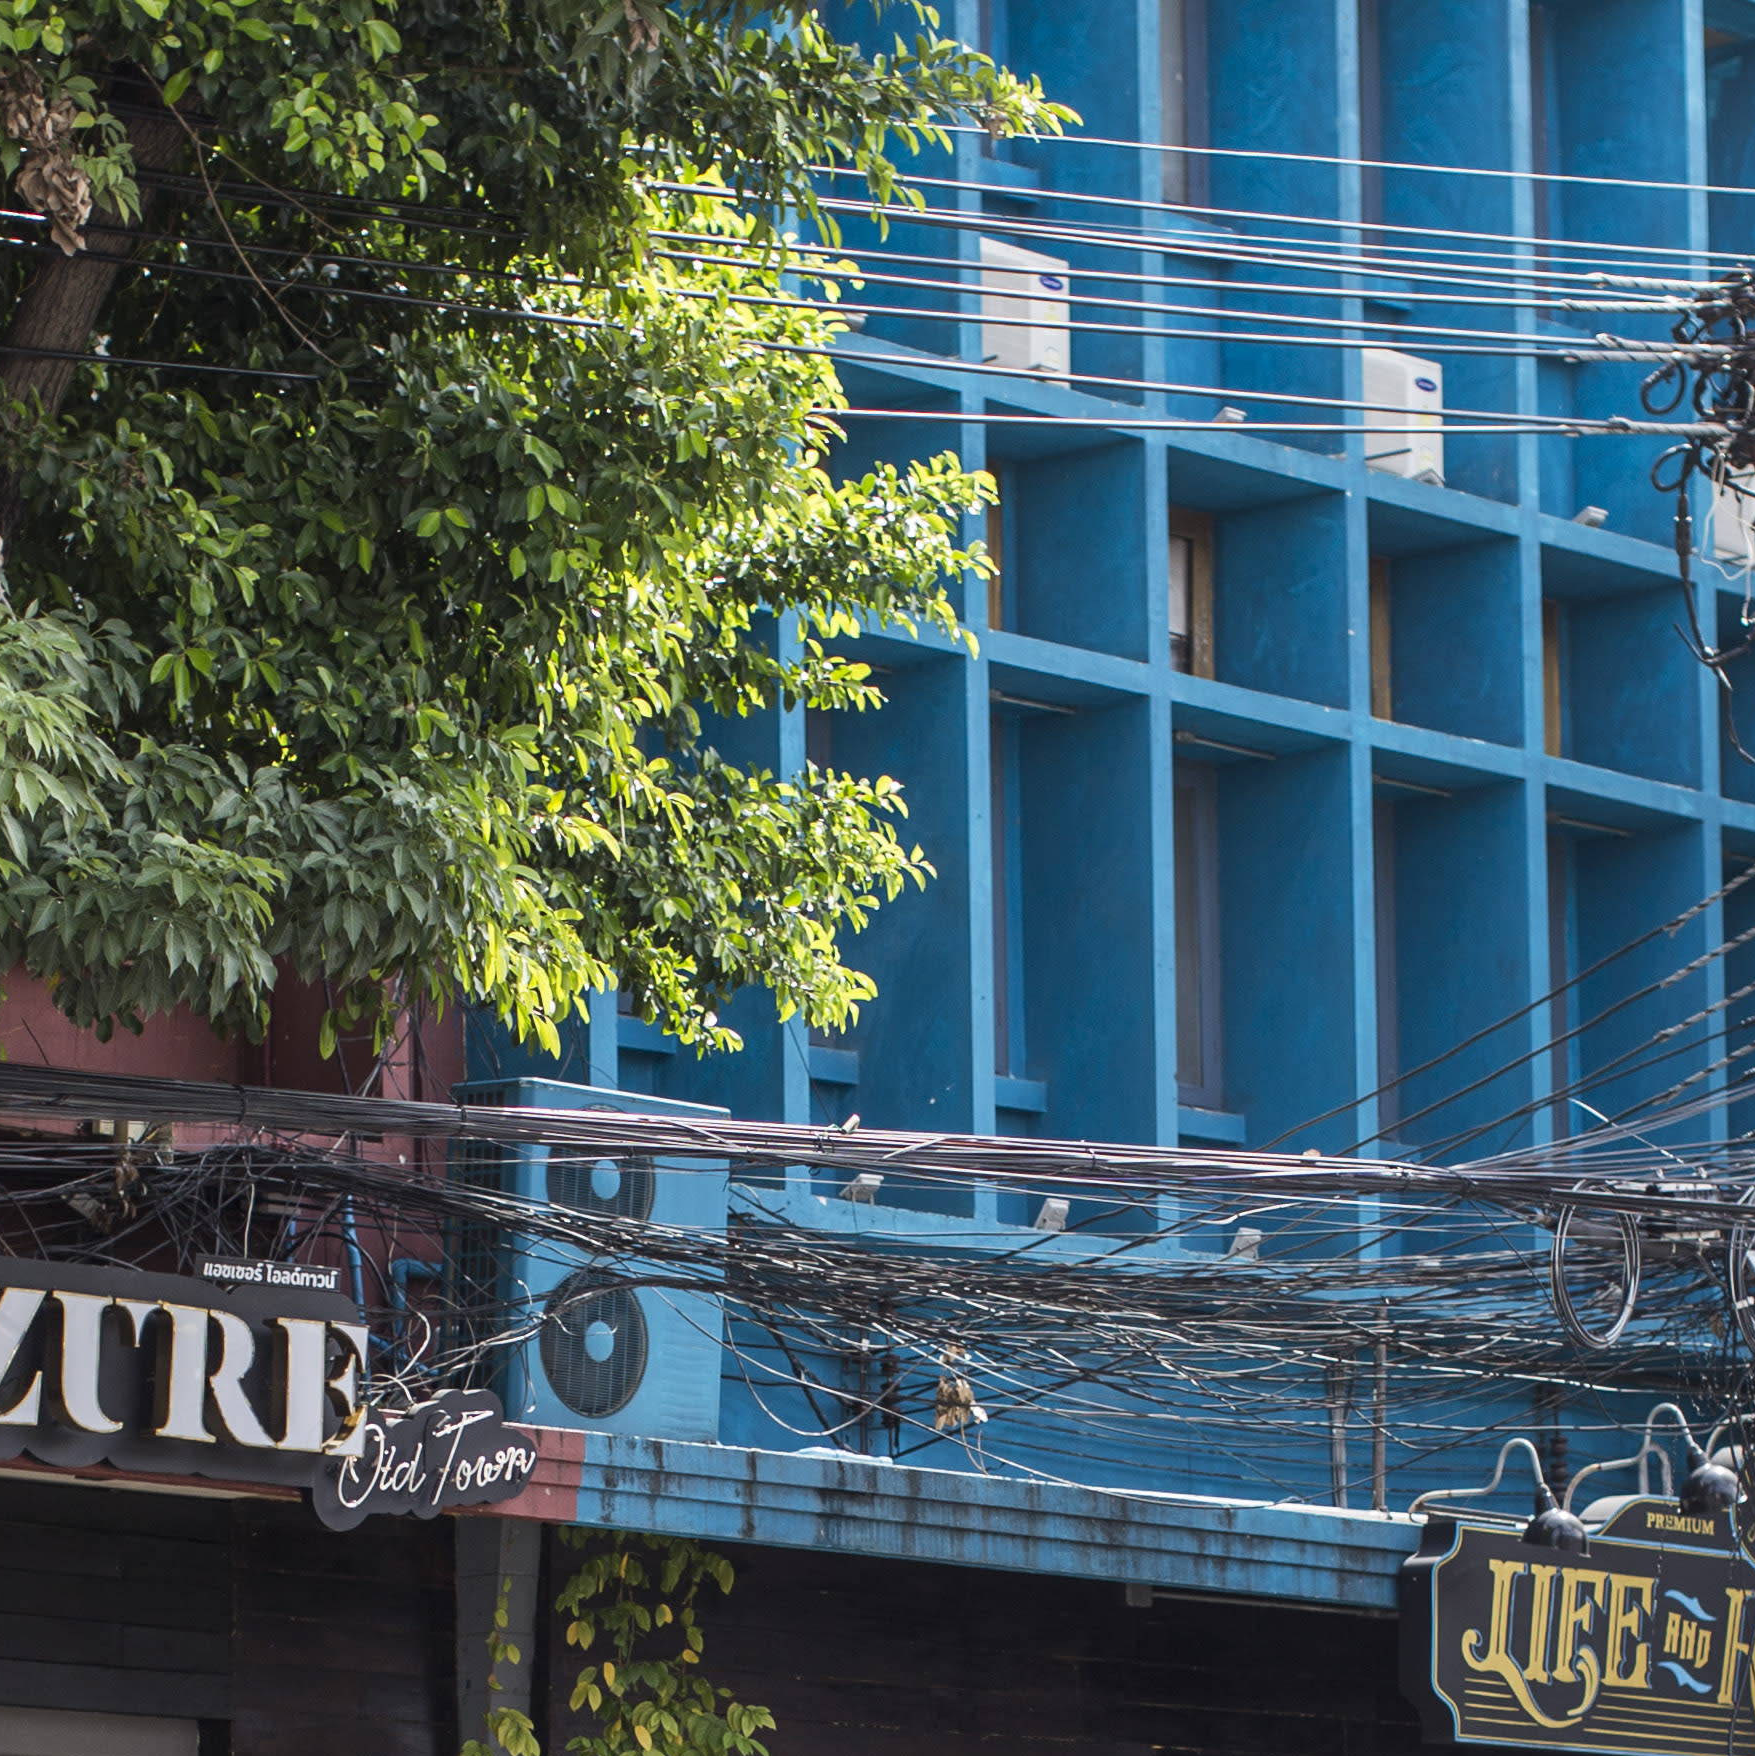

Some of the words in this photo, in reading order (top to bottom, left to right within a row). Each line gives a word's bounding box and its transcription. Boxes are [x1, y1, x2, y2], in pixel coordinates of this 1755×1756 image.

[266, 1264, 338, 1289] โอลด์ทาวน์
[431, 1410, 536, 1505] Town
[1646, 1511, 1715, 1536] PREMIUM
[1461, 1558, 1659, 1730] LIFE
[1663, 1611, 1712, 1669] AND
